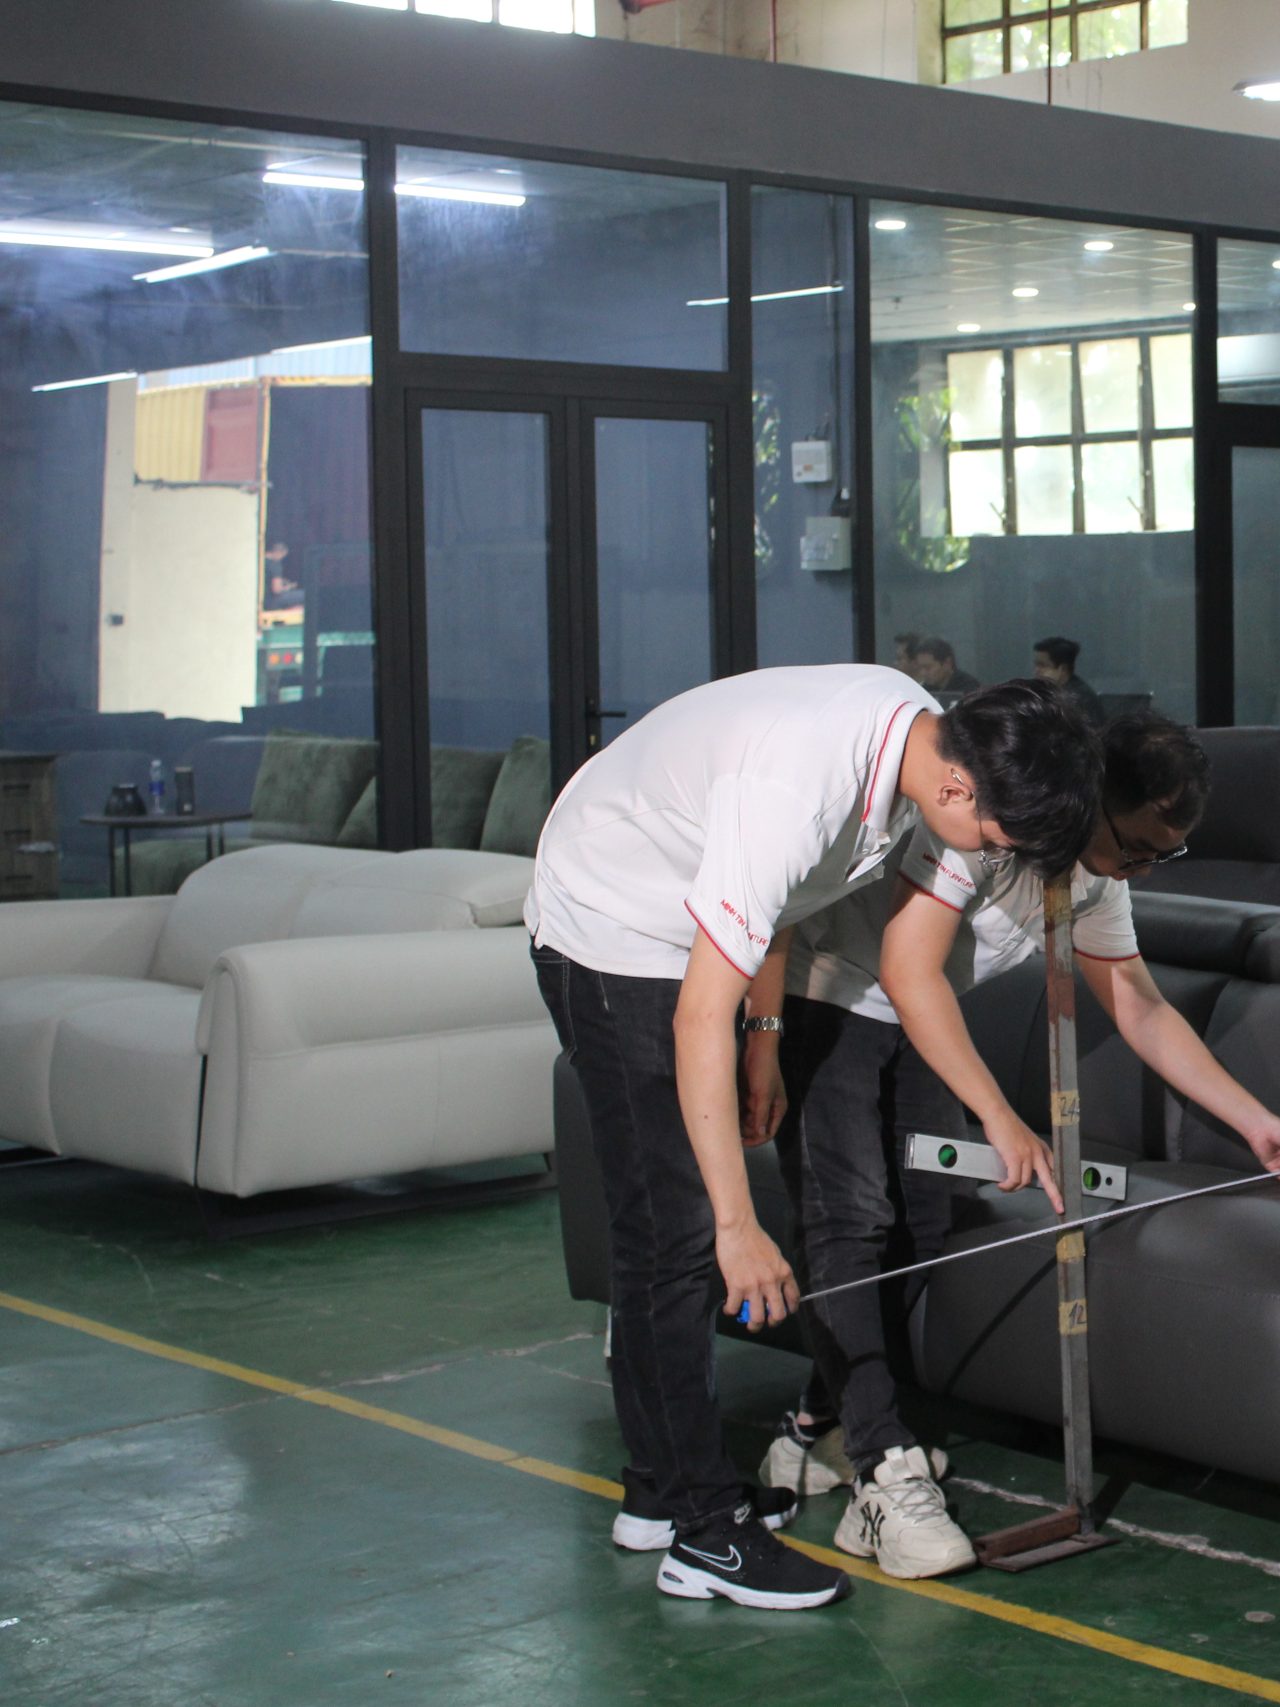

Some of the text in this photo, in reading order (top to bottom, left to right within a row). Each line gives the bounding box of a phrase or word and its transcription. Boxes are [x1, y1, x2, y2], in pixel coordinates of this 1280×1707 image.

[735, 914, 746, 927] TIN
[747, 932, 769, 946] NITURE
[1068, 1301, 1087, 1327] 12
